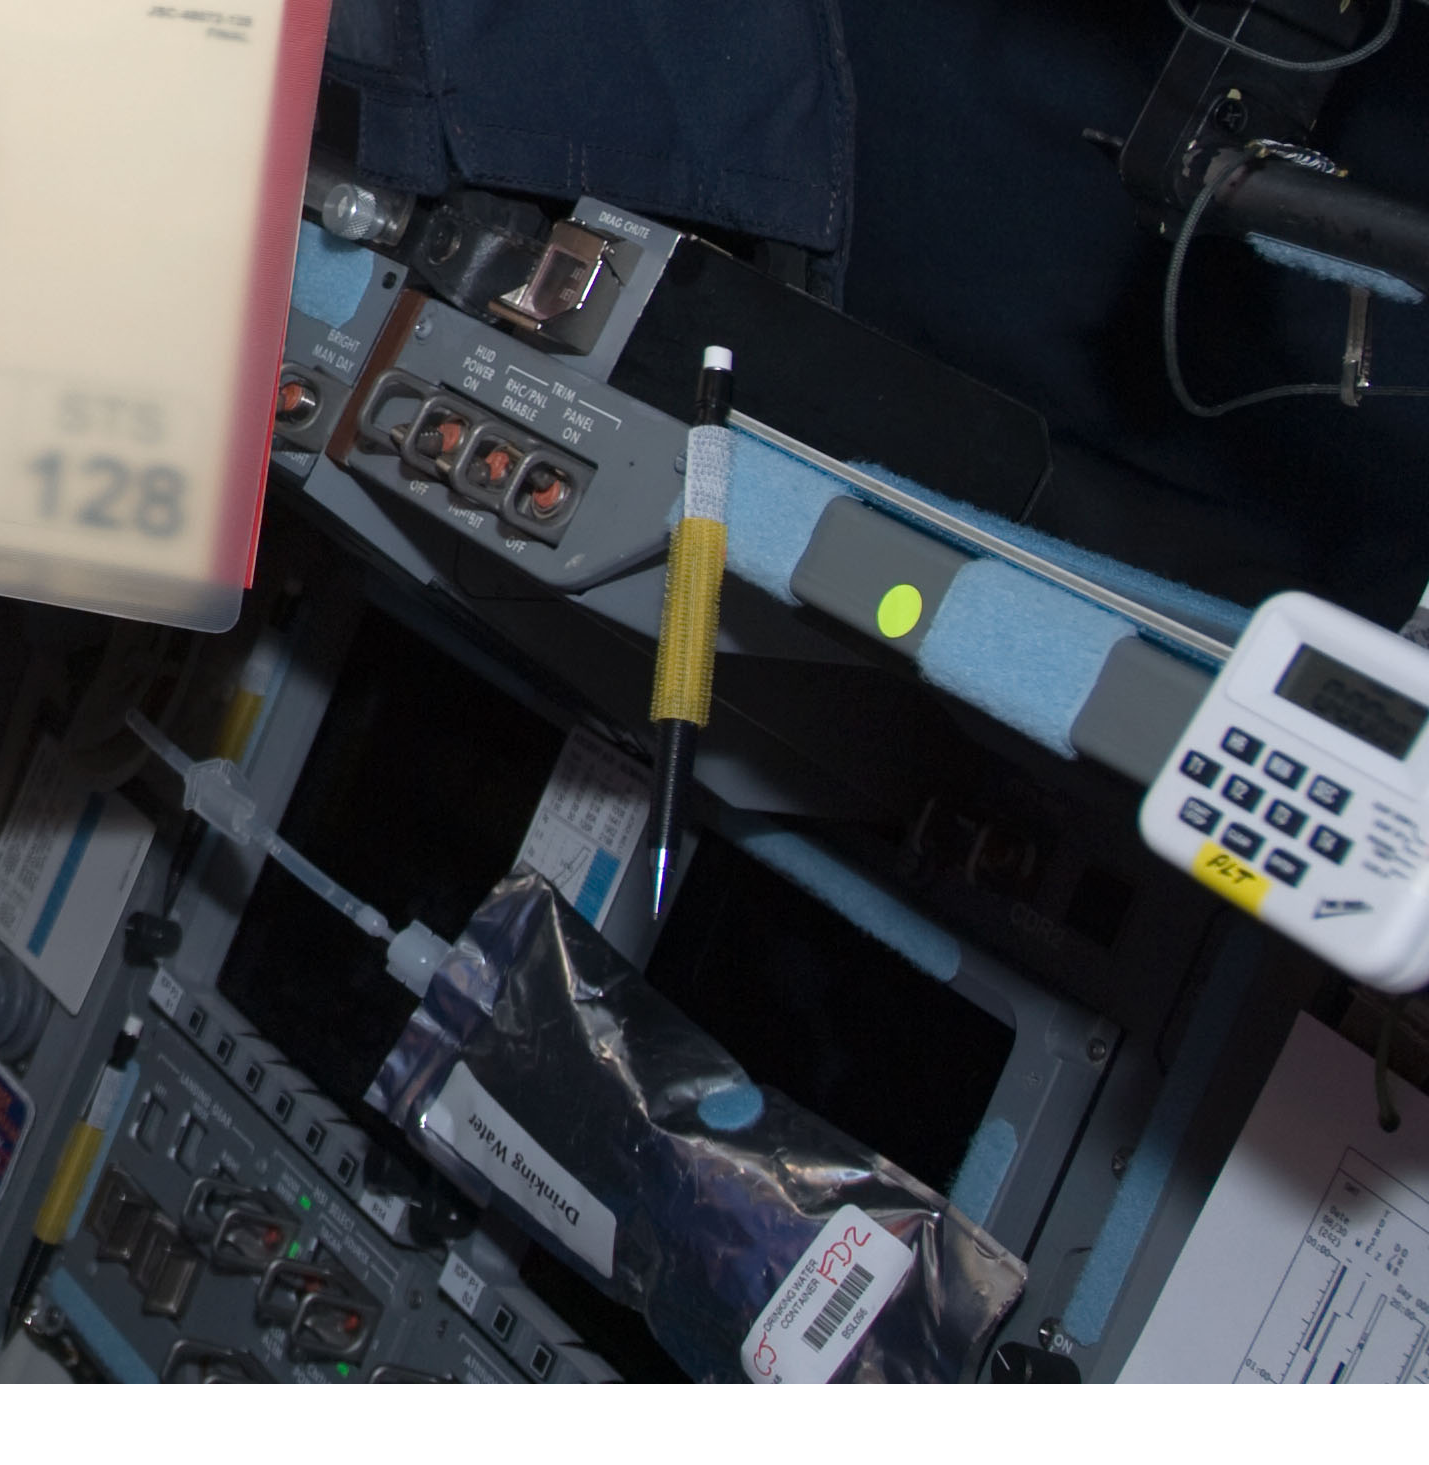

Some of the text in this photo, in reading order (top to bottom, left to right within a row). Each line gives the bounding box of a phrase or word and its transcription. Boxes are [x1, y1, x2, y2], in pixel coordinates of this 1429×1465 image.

[598, 211, 651, 239] DRAG CHUTE
[327, 329, 362, 354] BRIGHT
[475, 344, 497, 363] HUD
[312, 344, 356, 373] MAN DAY
[462, 357, 496, 381] POWER
[463, 376, 481, 392] ON
[505, 378, 548, 409] RHC/PNL
[551, 381, 577, 403] TRIM
[58, 390, 166, 445] STS
[502, 395, 539, 422] ENABLE
[563, 408, 596, 433] PANEL
[562, 427, 582, 445] ON
[29, 451, 190, 540] 128
[410, 480, 430, 496] OFF
[505, 537, 527, 554] OFF
[1207, 854, 1256, 884] PLT
[468, 1114, 581, 1226] Drinking Water
[763, 1258, 818, 1333] DRINKING WATER
[780, 1278, 821, 1330] CONTAINER
[1053, 1333, 1073, 1354] ON
